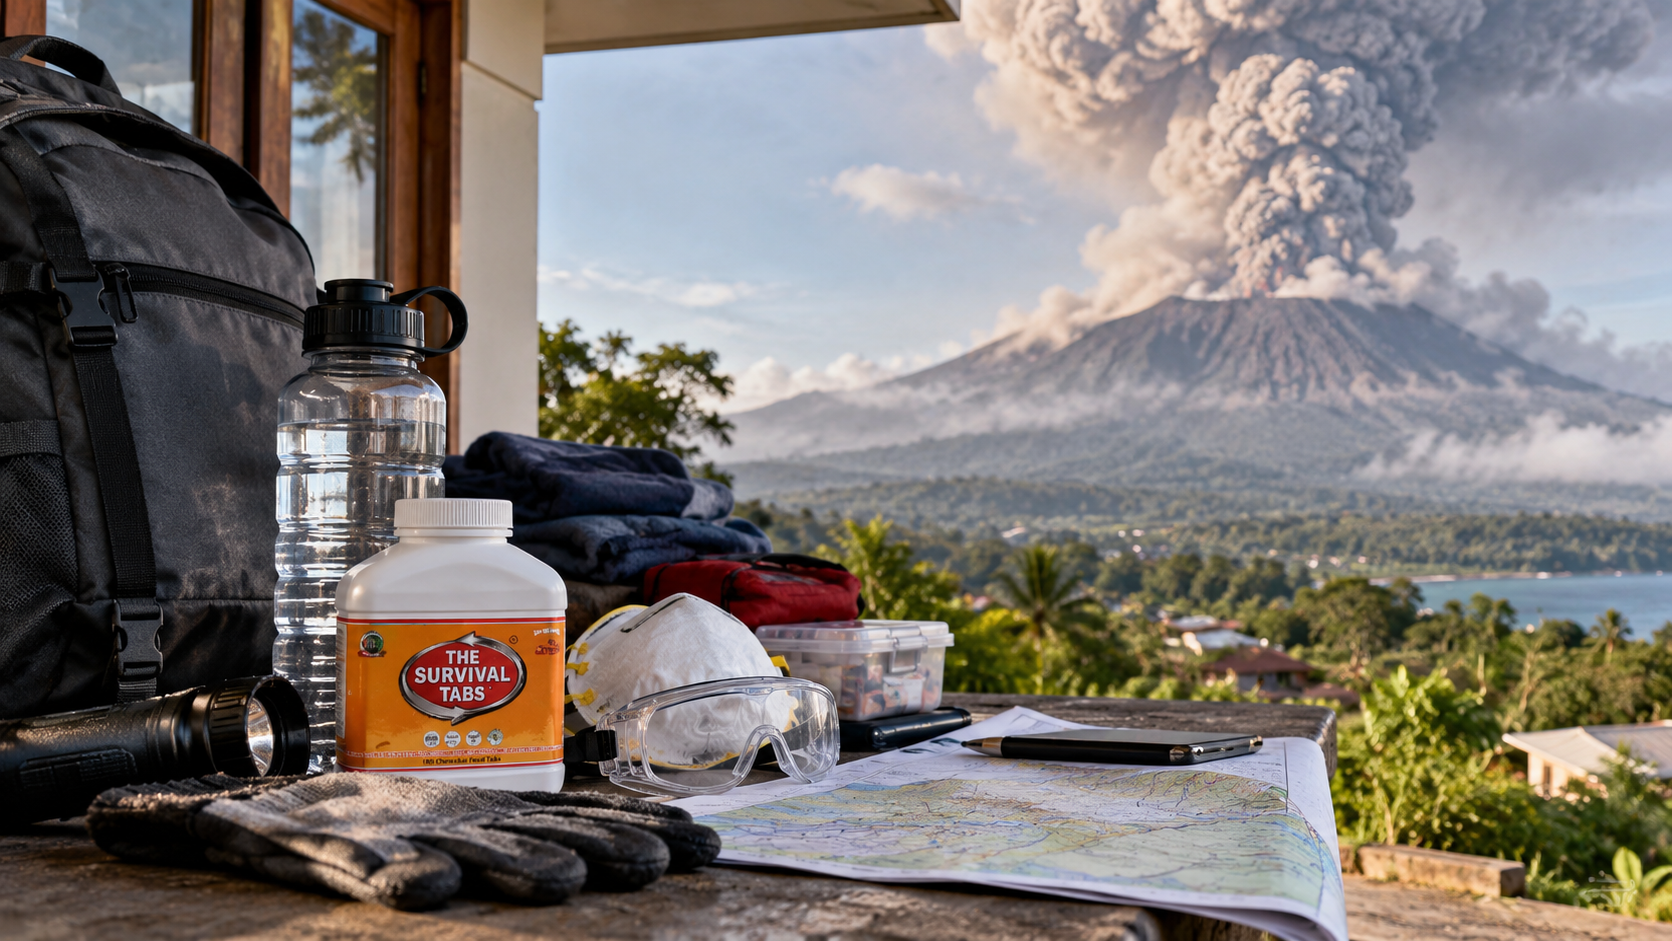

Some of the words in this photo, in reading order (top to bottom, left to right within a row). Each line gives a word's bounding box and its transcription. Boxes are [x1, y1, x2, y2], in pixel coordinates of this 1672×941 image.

[445, 650, 480, 665] THE
[414, 666, 511, 684] SURVIVAL
[439, 686, 485, 702] TABS
